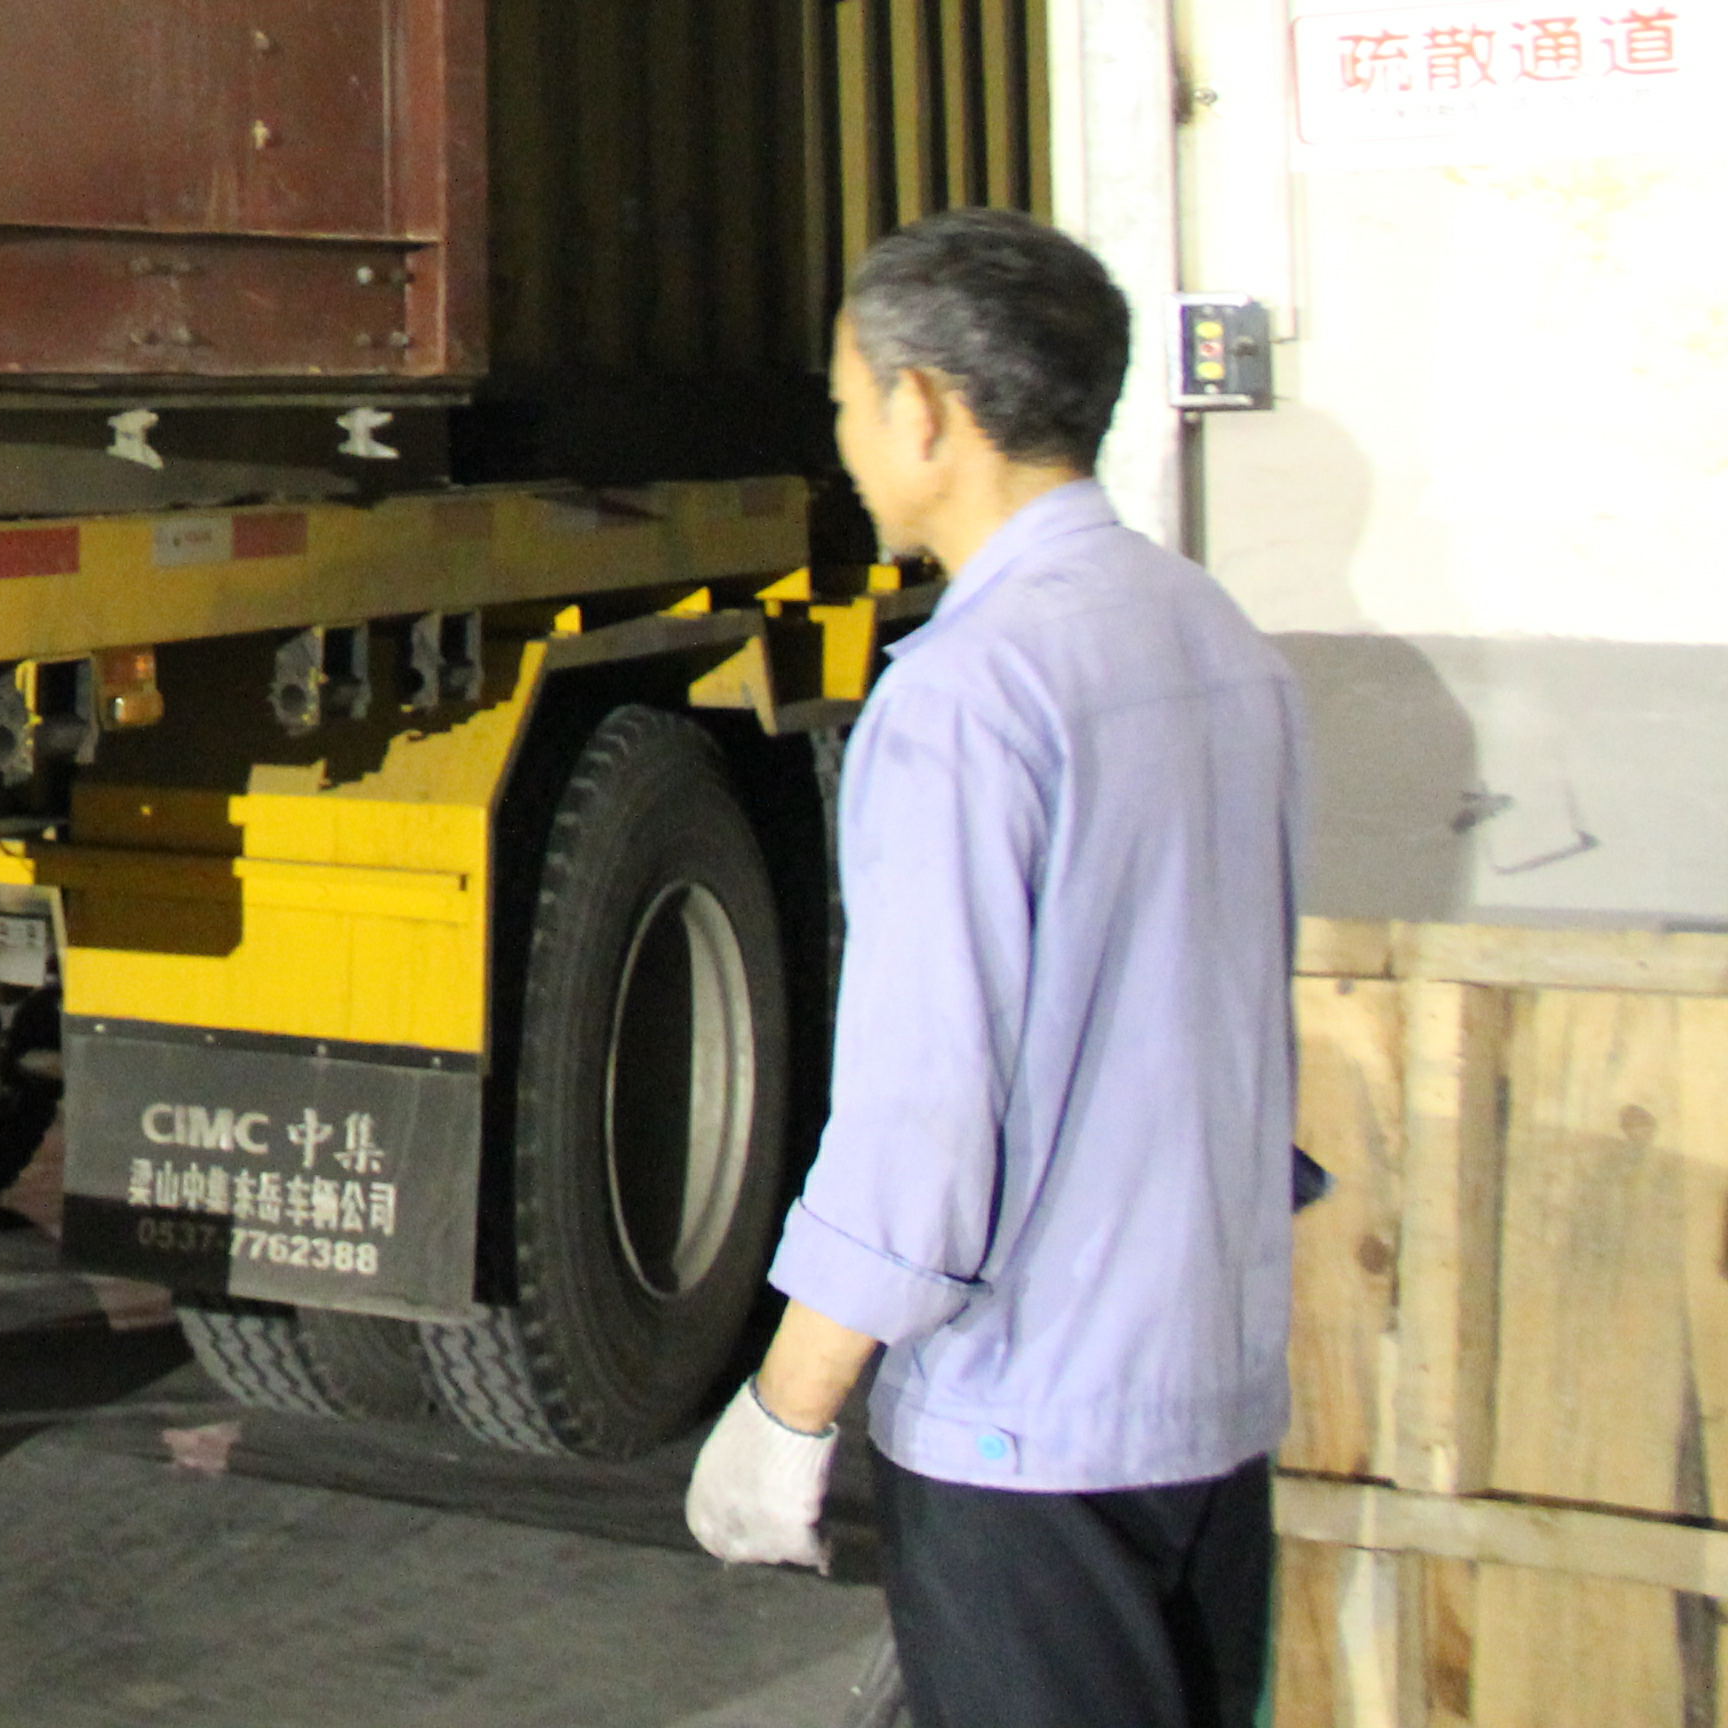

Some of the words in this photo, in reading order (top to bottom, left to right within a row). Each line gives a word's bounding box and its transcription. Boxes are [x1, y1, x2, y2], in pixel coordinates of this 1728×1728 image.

[1337, 7, 1681, 94] 疏散通道
[141, 1103, 270, 1155] CIMC
[286, 1107, 385, 1175] 中集
